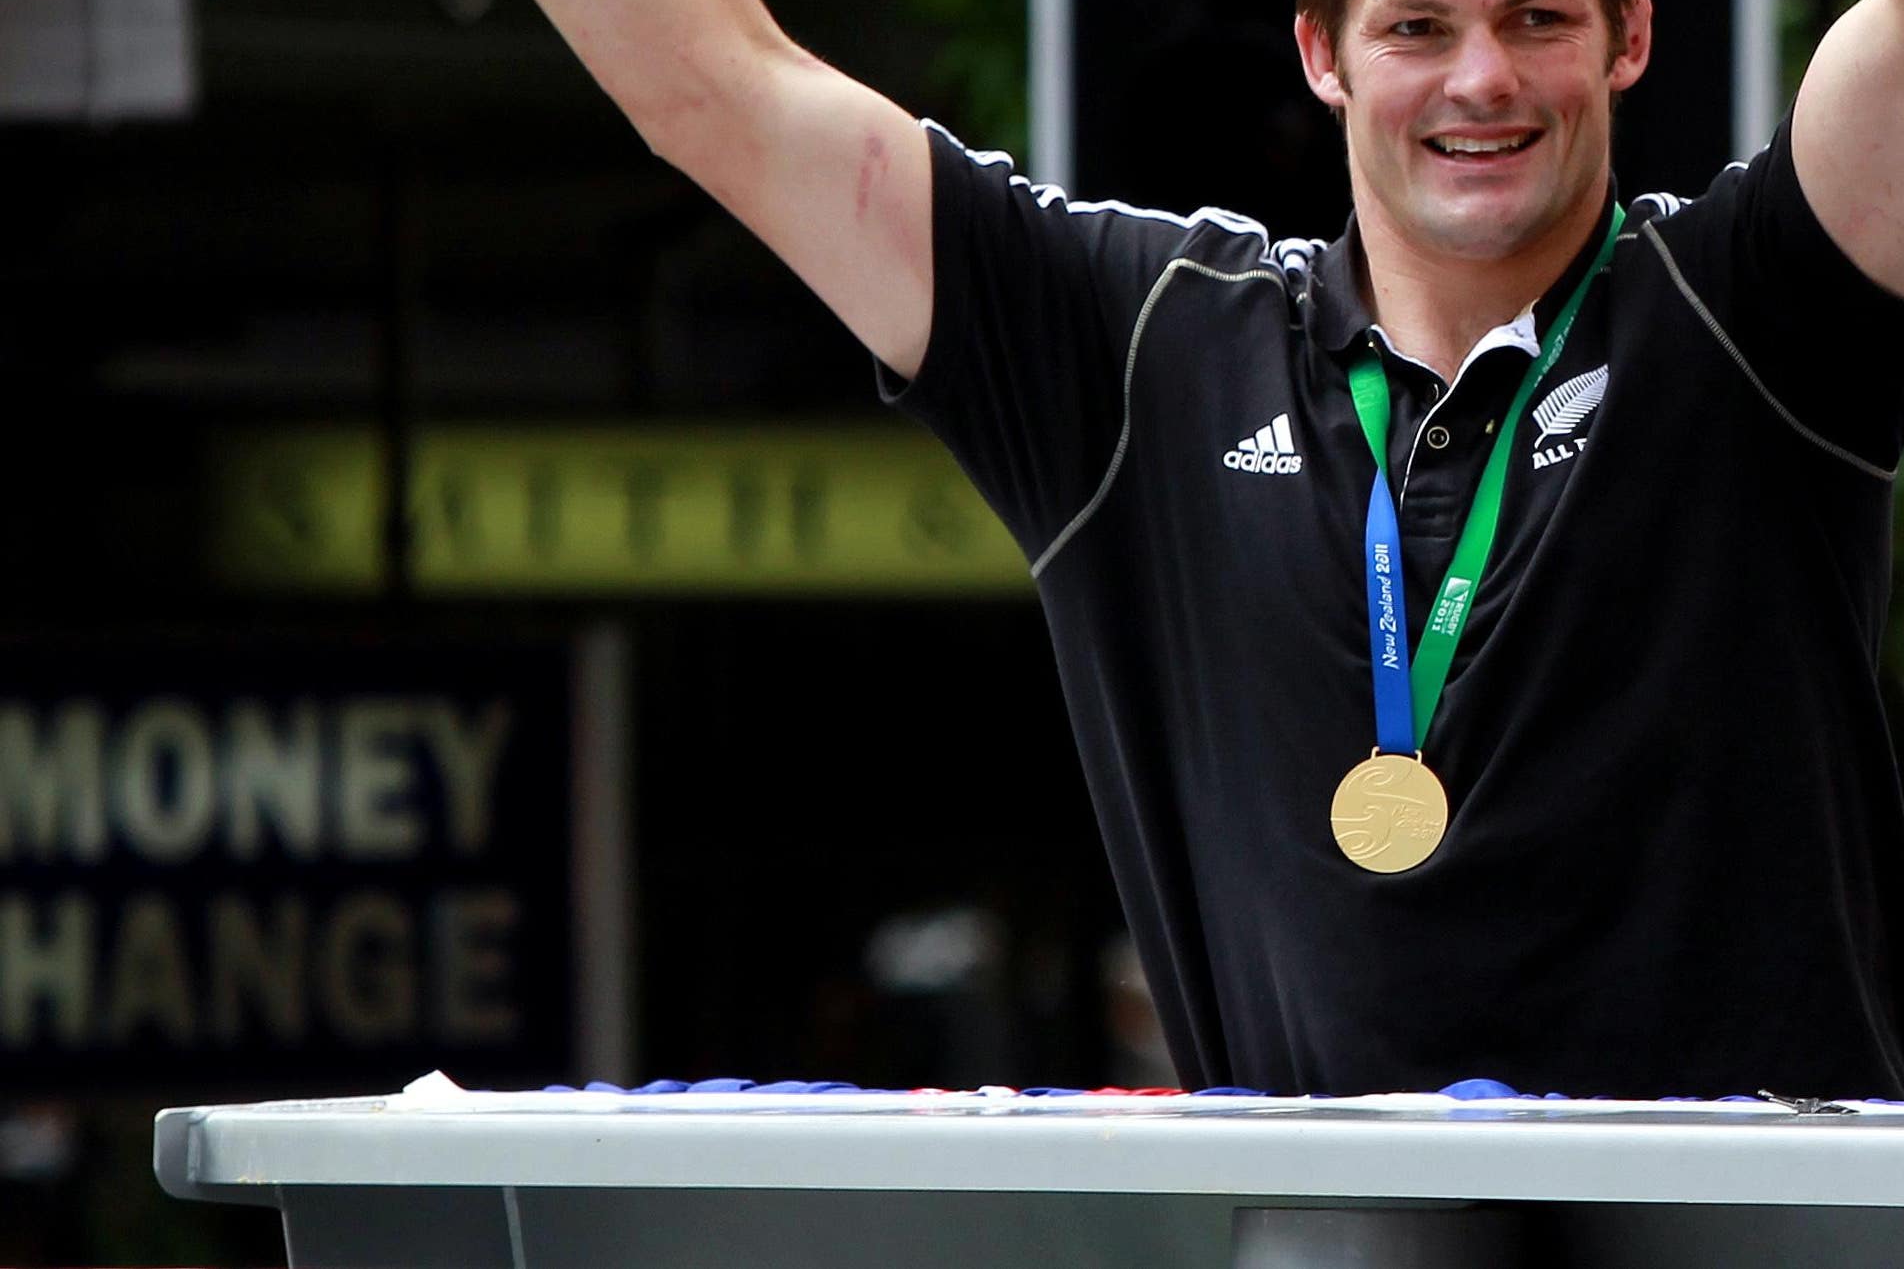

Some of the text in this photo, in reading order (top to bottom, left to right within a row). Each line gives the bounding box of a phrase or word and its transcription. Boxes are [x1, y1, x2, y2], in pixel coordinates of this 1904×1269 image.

[1222, 449, 1303, 474] adidas
[1532, 443, 1574, 470] ALL
[1374, 543, 1400, 670] New Zealand 2011
[1431, 599, 1451, 632] 2011
[1447, 601, 1465, 637] RUGBY
[0, 696, 512, 861] MONEY
